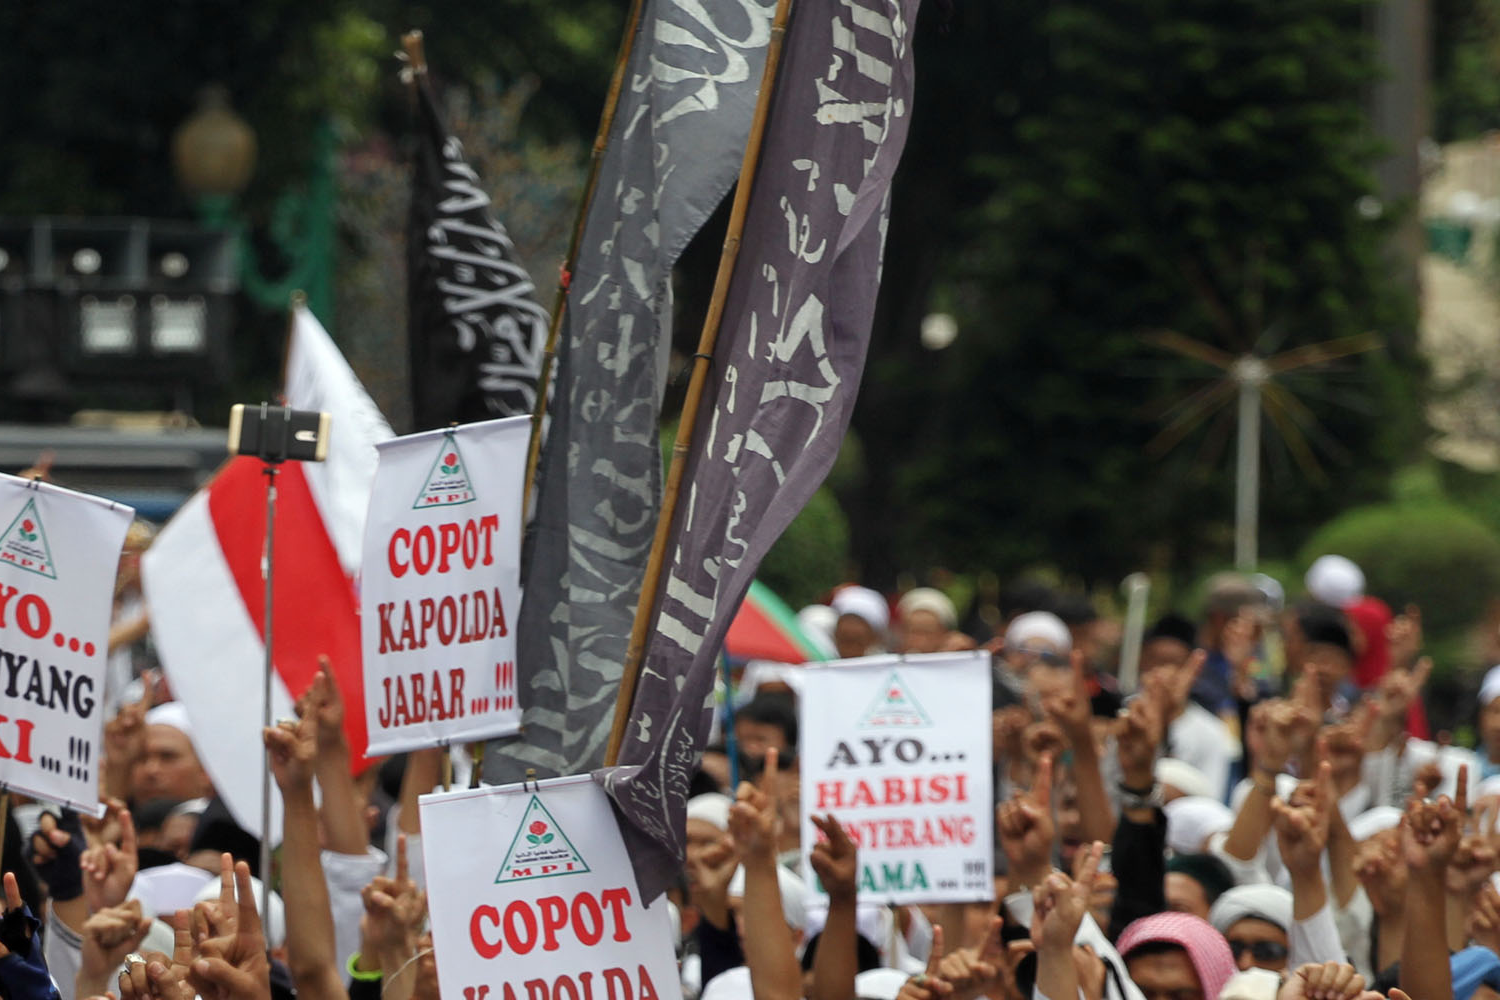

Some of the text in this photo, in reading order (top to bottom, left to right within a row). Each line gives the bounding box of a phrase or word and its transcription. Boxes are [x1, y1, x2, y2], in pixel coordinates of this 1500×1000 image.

[388, 513, 499, 578] COPOT
[378, 586, 508, 655] KAPOLDA
[379, 667, 465, 729] JABAR
[816, 773, 969, 810] HABISI
[815, 816, 976, 851] NYERANG
[469, 886, 633, 960] COPOT
